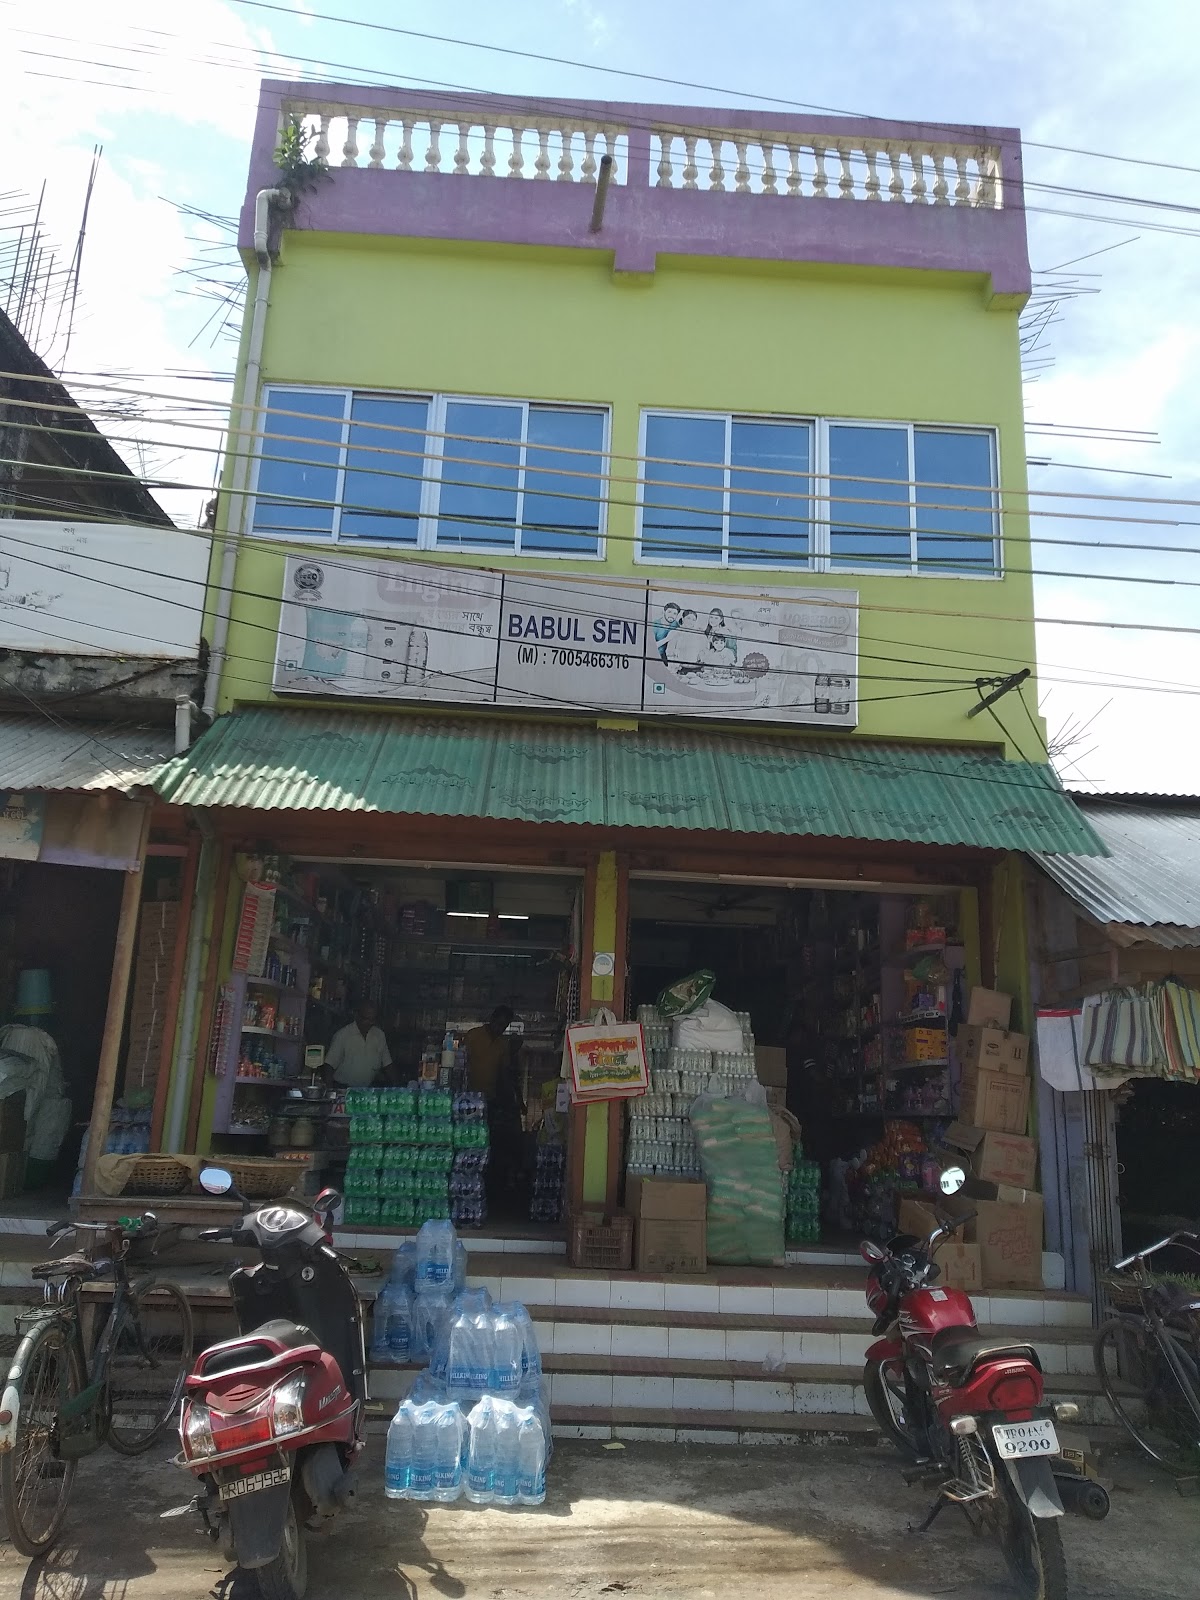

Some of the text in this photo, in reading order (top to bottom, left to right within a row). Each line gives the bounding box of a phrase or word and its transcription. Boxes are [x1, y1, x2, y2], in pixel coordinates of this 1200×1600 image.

[508, 613, 637, 645] BABUL SEN
[517, 645, 538, 666] (M)
[551, 649, 630, 670] 7005466316
[1004, 1437, 1051, 1454] 9200
